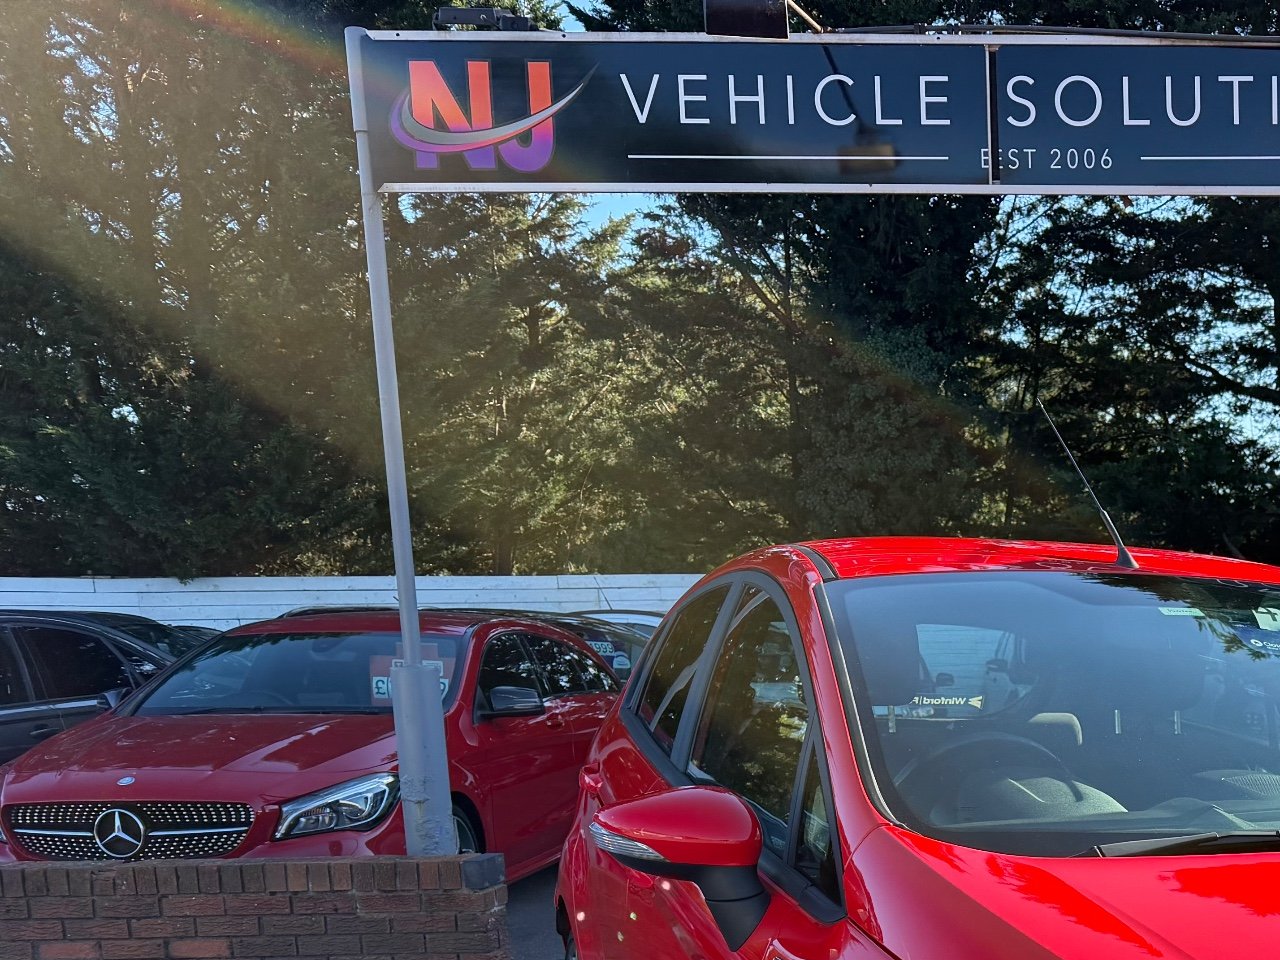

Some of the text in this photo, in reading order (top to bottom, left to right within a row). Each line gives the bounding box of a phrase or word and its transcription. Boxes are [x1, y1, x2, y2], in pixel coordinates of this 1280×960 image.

[409, 60, 555, 173] NJ
[620, 74, 951, 126] VEHICLE
[1050, 148, 1112, 169] 2006
